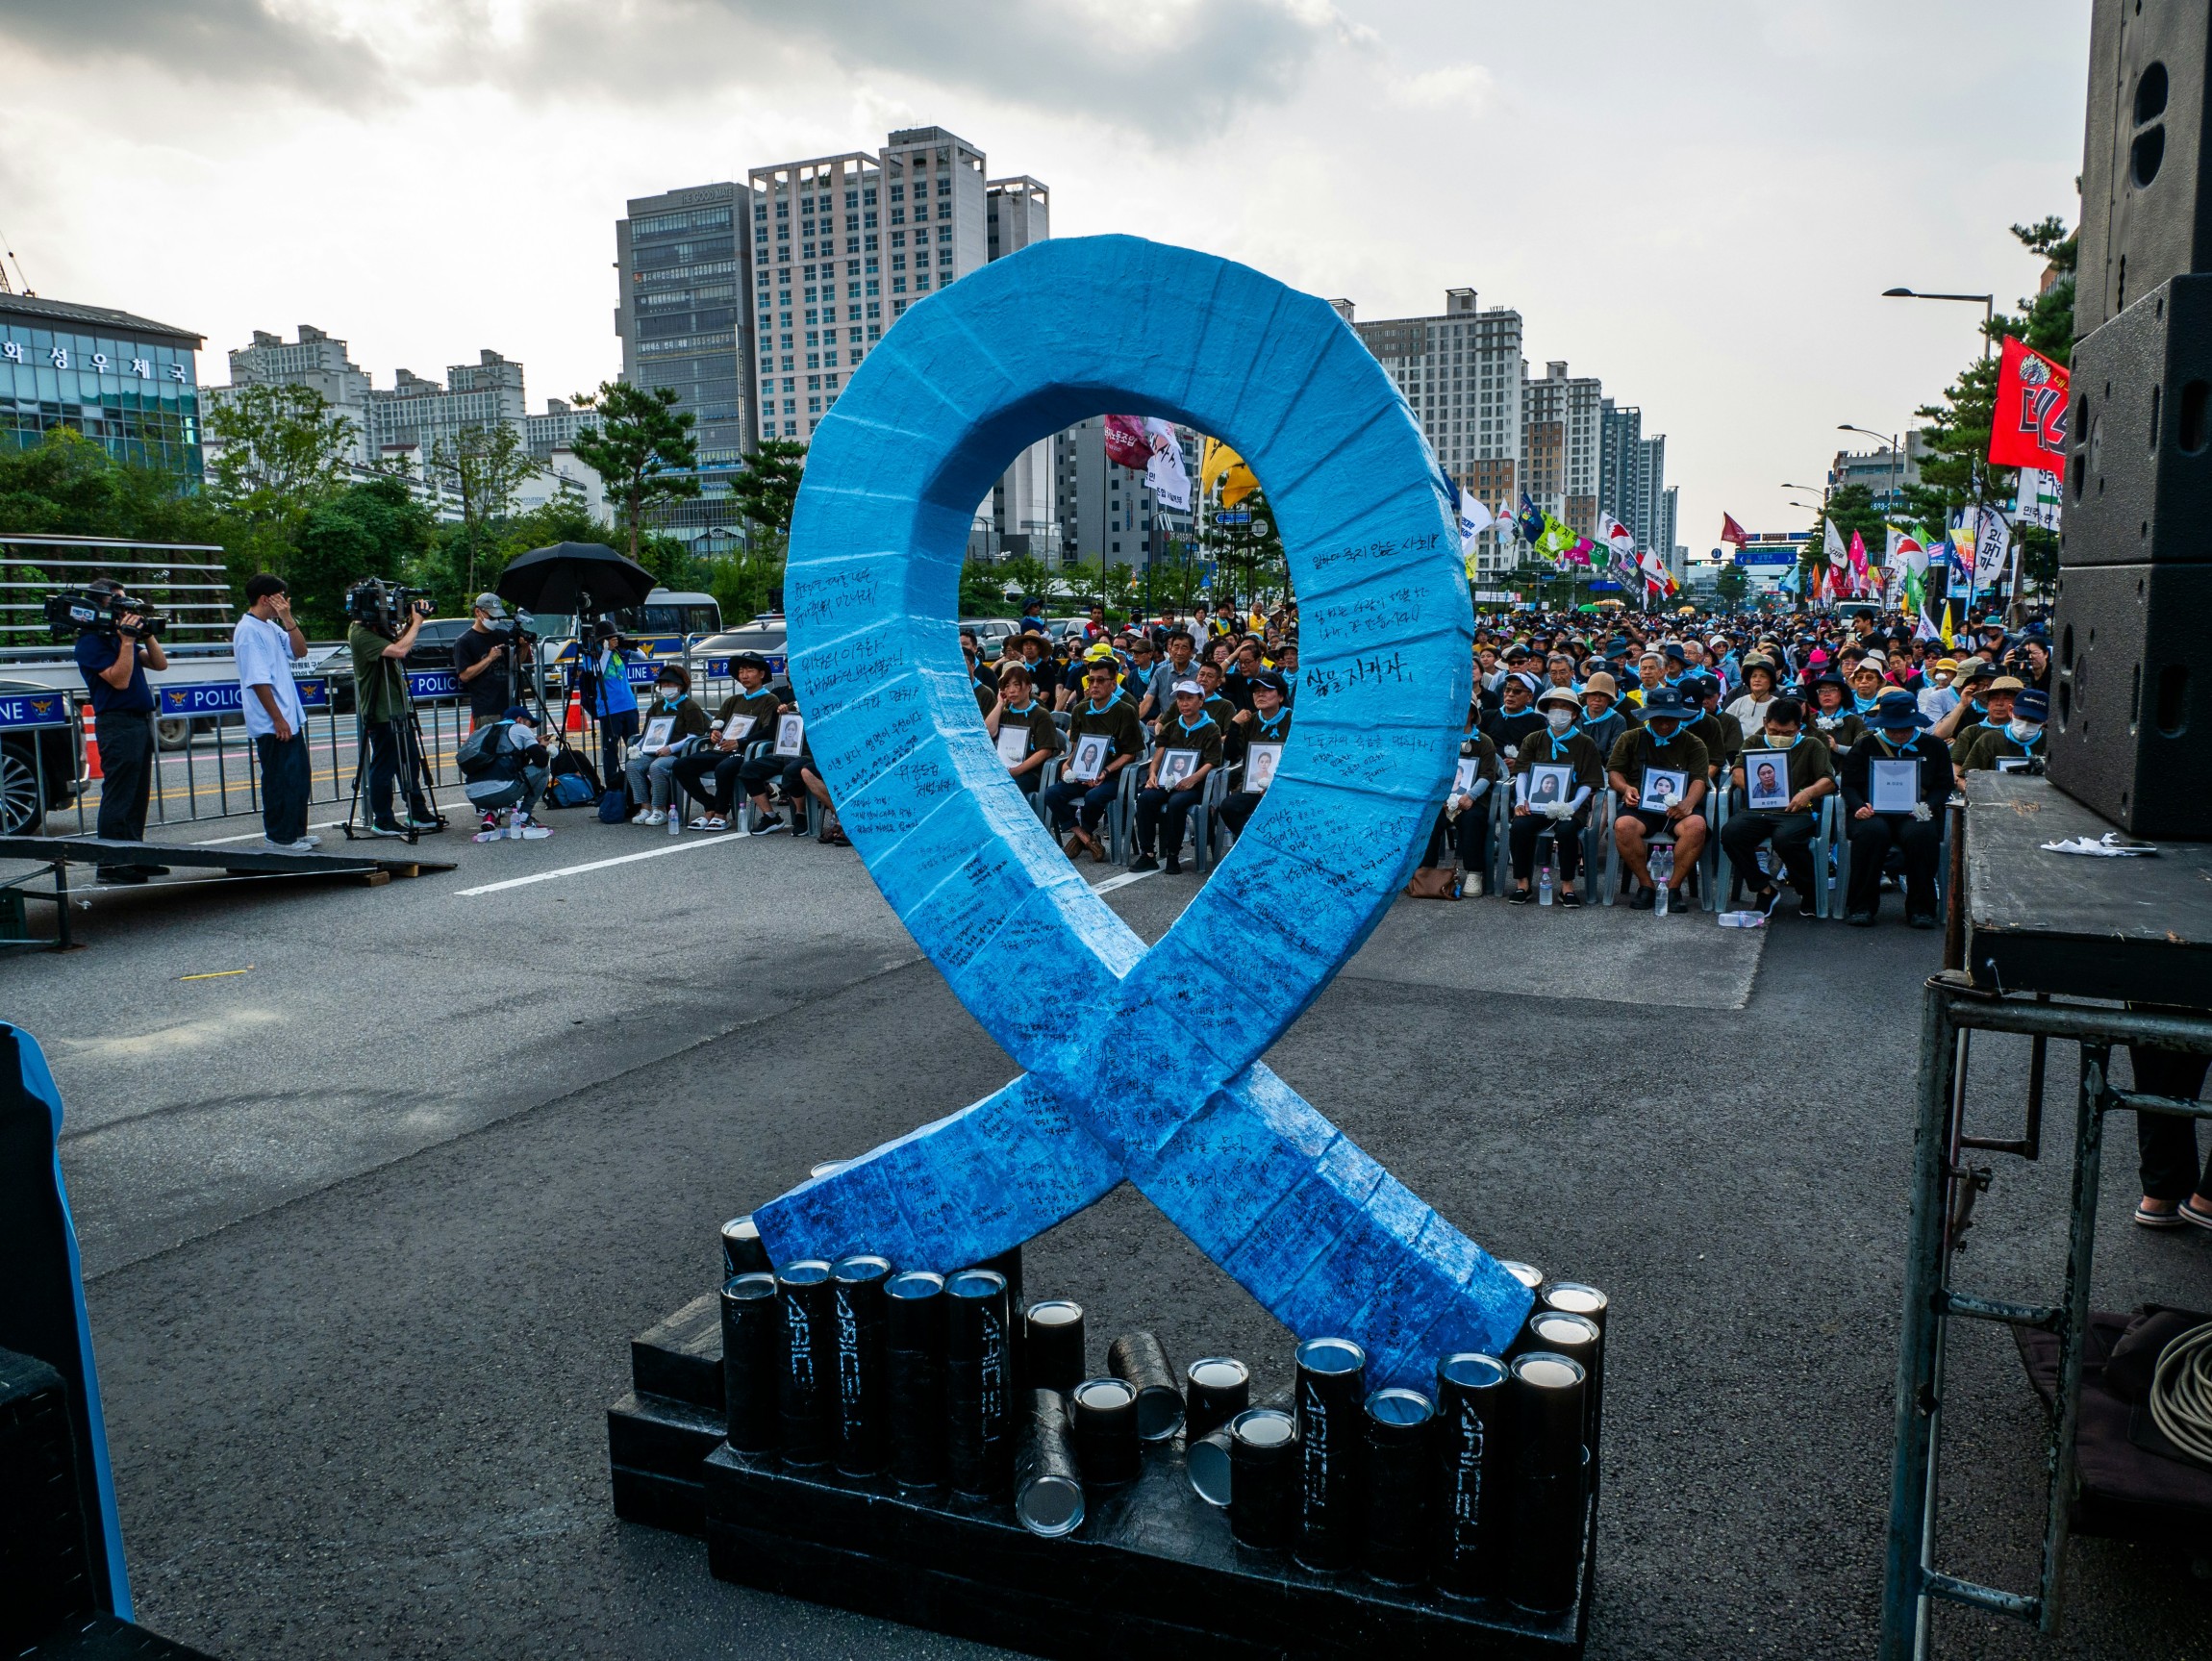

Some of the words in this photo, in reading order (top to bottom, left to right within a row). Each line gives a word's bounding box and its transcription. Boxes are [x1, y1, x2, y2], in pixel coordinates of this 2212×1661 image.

[693, 189, 715, 203] GOOD
[716, 186, 734, 200] MATE
[3, 340, 188, 384] 화성우체국
[628, 666, 647, 679] LINE
[418, 677, 465, 692] POLICE
[195, 688, 241, 707] POLIC
[865, 727, 891, 751] 생명이
[892, 713, 923, 735] 우선이다
